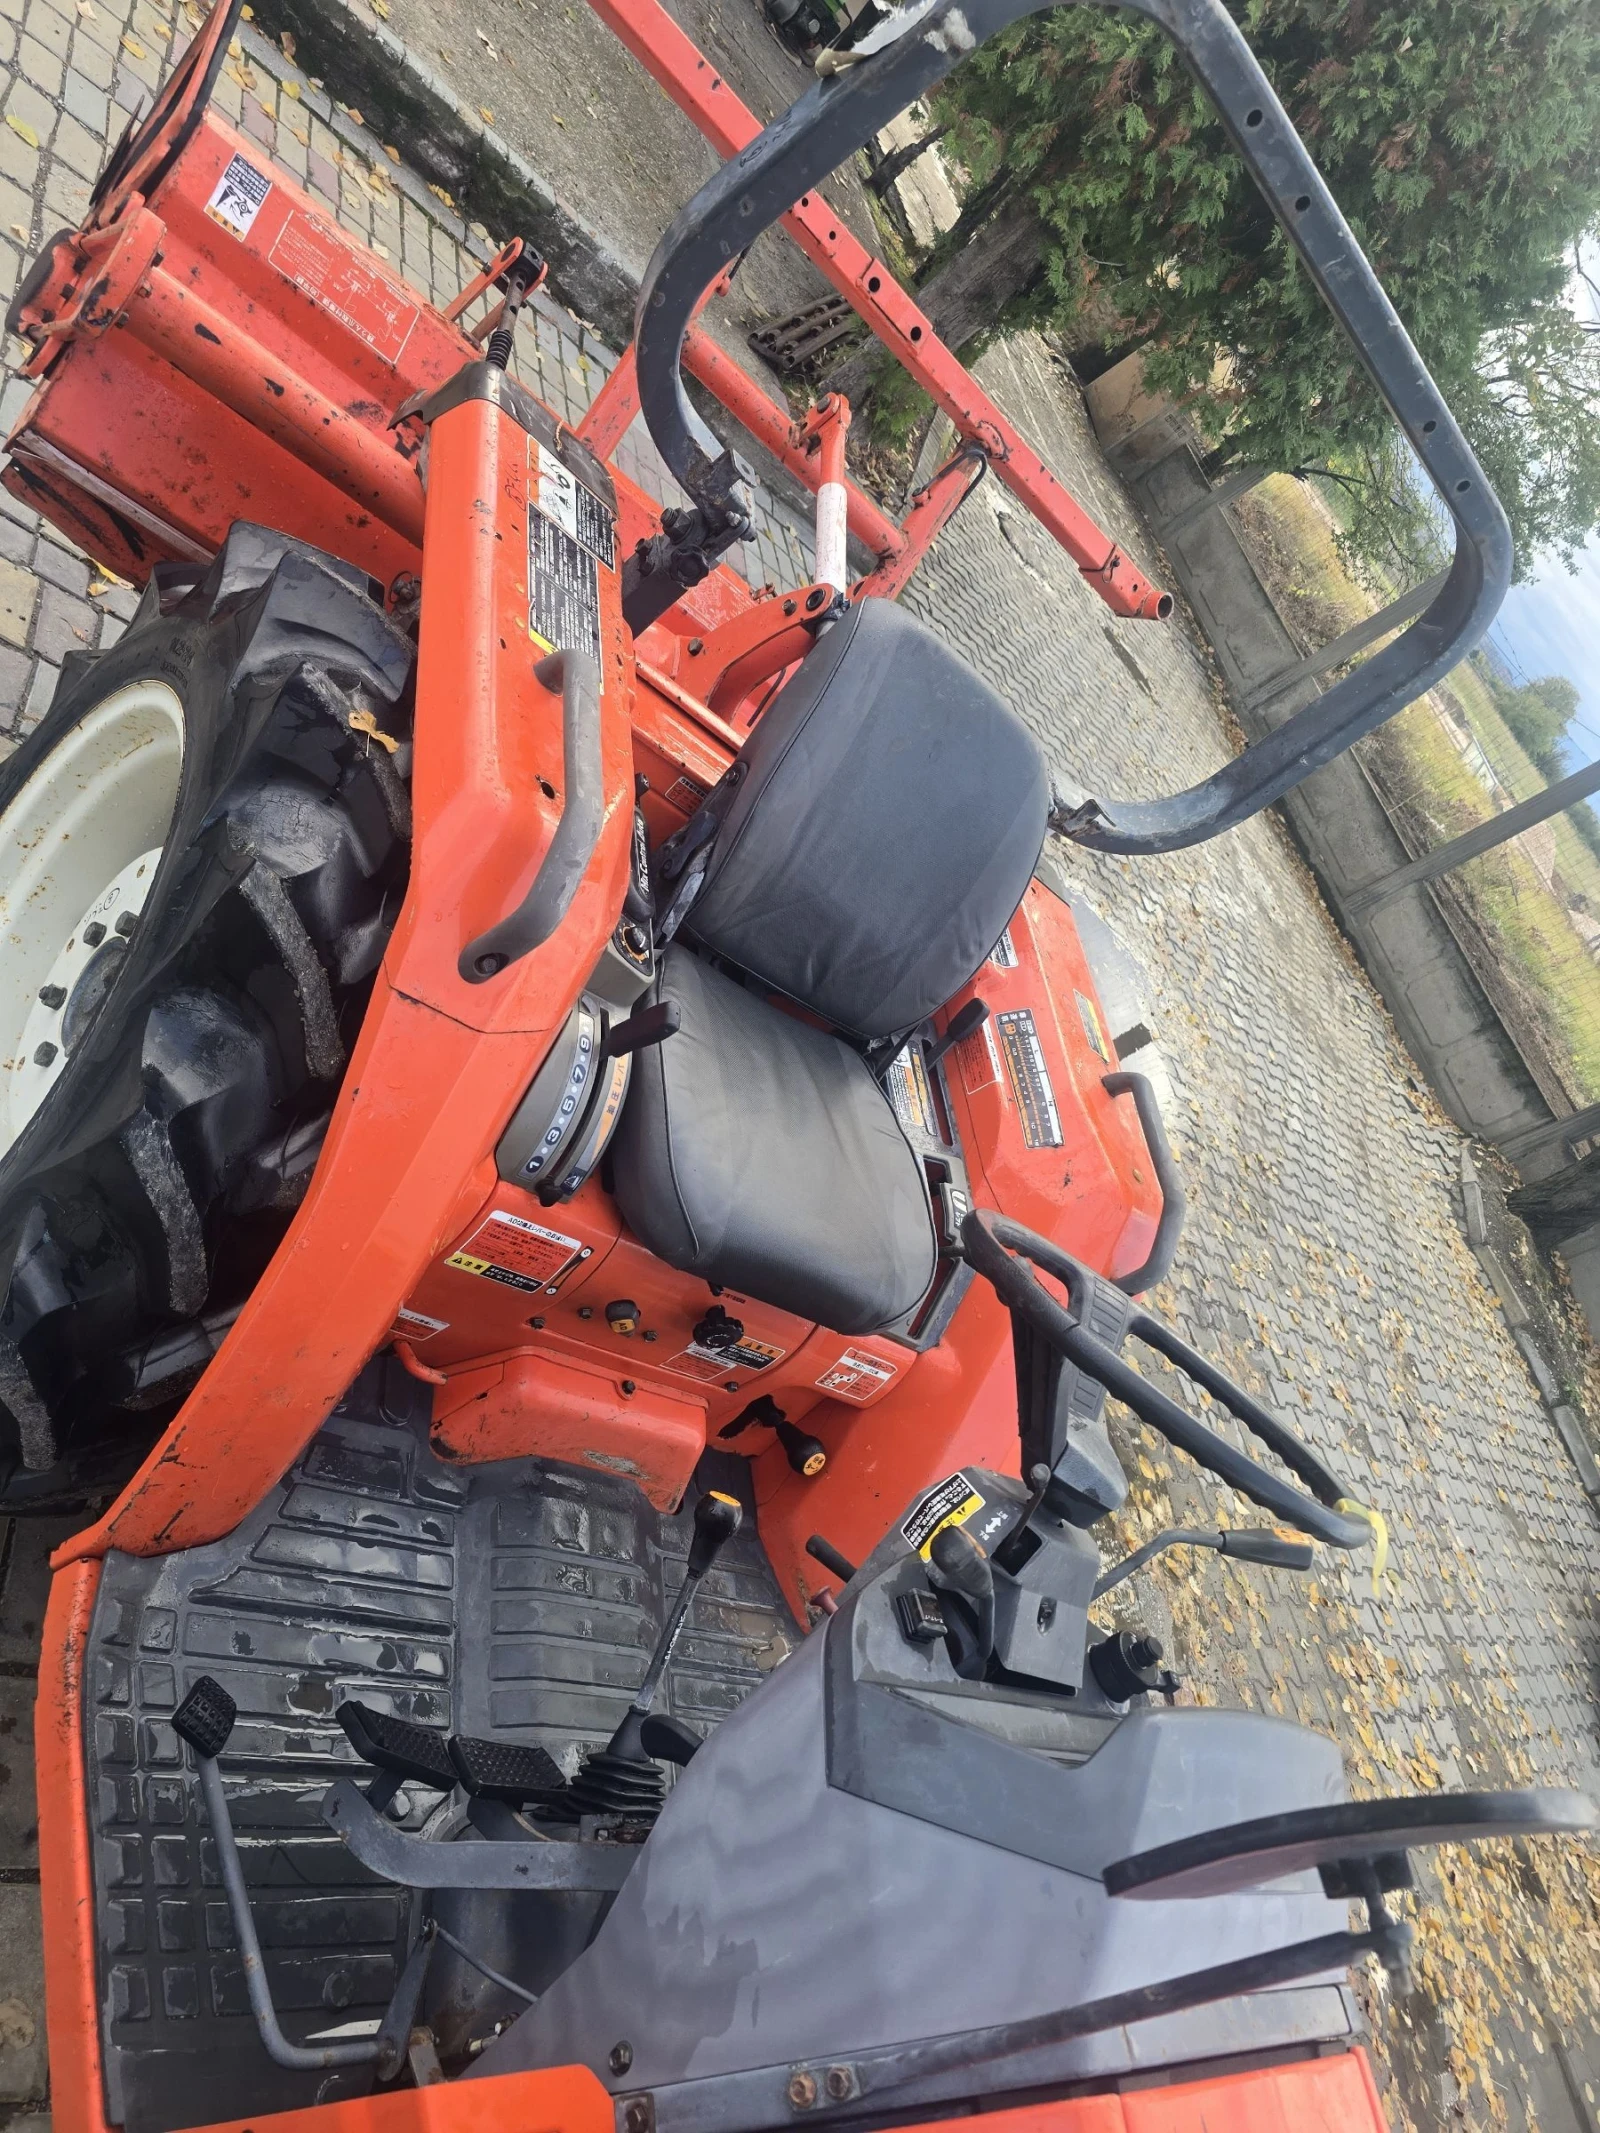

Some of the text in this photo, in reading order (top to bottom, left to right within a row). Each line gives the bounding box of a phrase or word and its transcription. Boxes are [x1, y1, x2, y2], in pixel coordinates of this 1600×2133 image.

[637, 841, 647, 873] Control
[529, 1037, 592, 1170] 1 3 5 7 9
[606, 1057, 627, 1114] 油圧レバ
